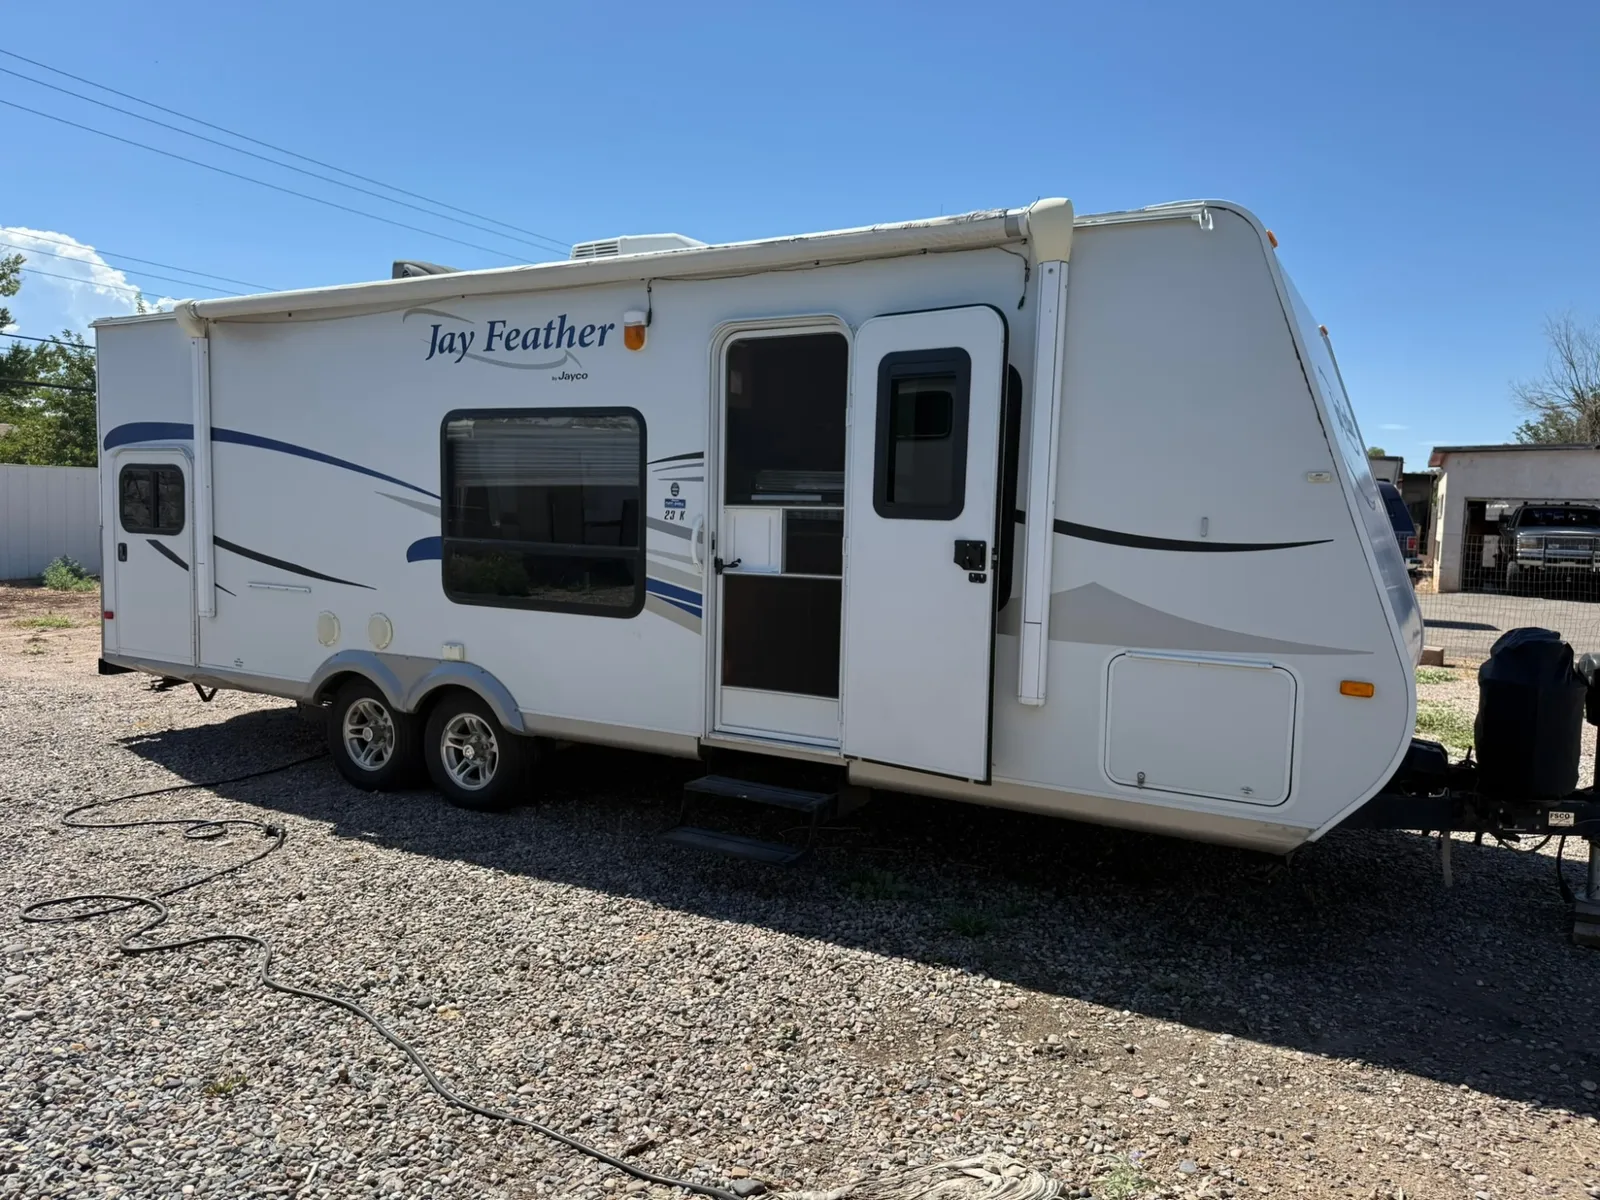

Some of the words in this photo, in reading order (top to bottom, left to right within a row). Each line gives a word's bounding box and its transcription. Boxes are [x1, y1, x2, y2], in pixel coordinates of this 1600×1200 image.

[425, 323, 474, 363] Jay
[483, 314, 615, 352] Feather
[558, 371, 588, 382] Jayco
[664, 509, 676, 520] 23
[679, 510, 686, 521] K
